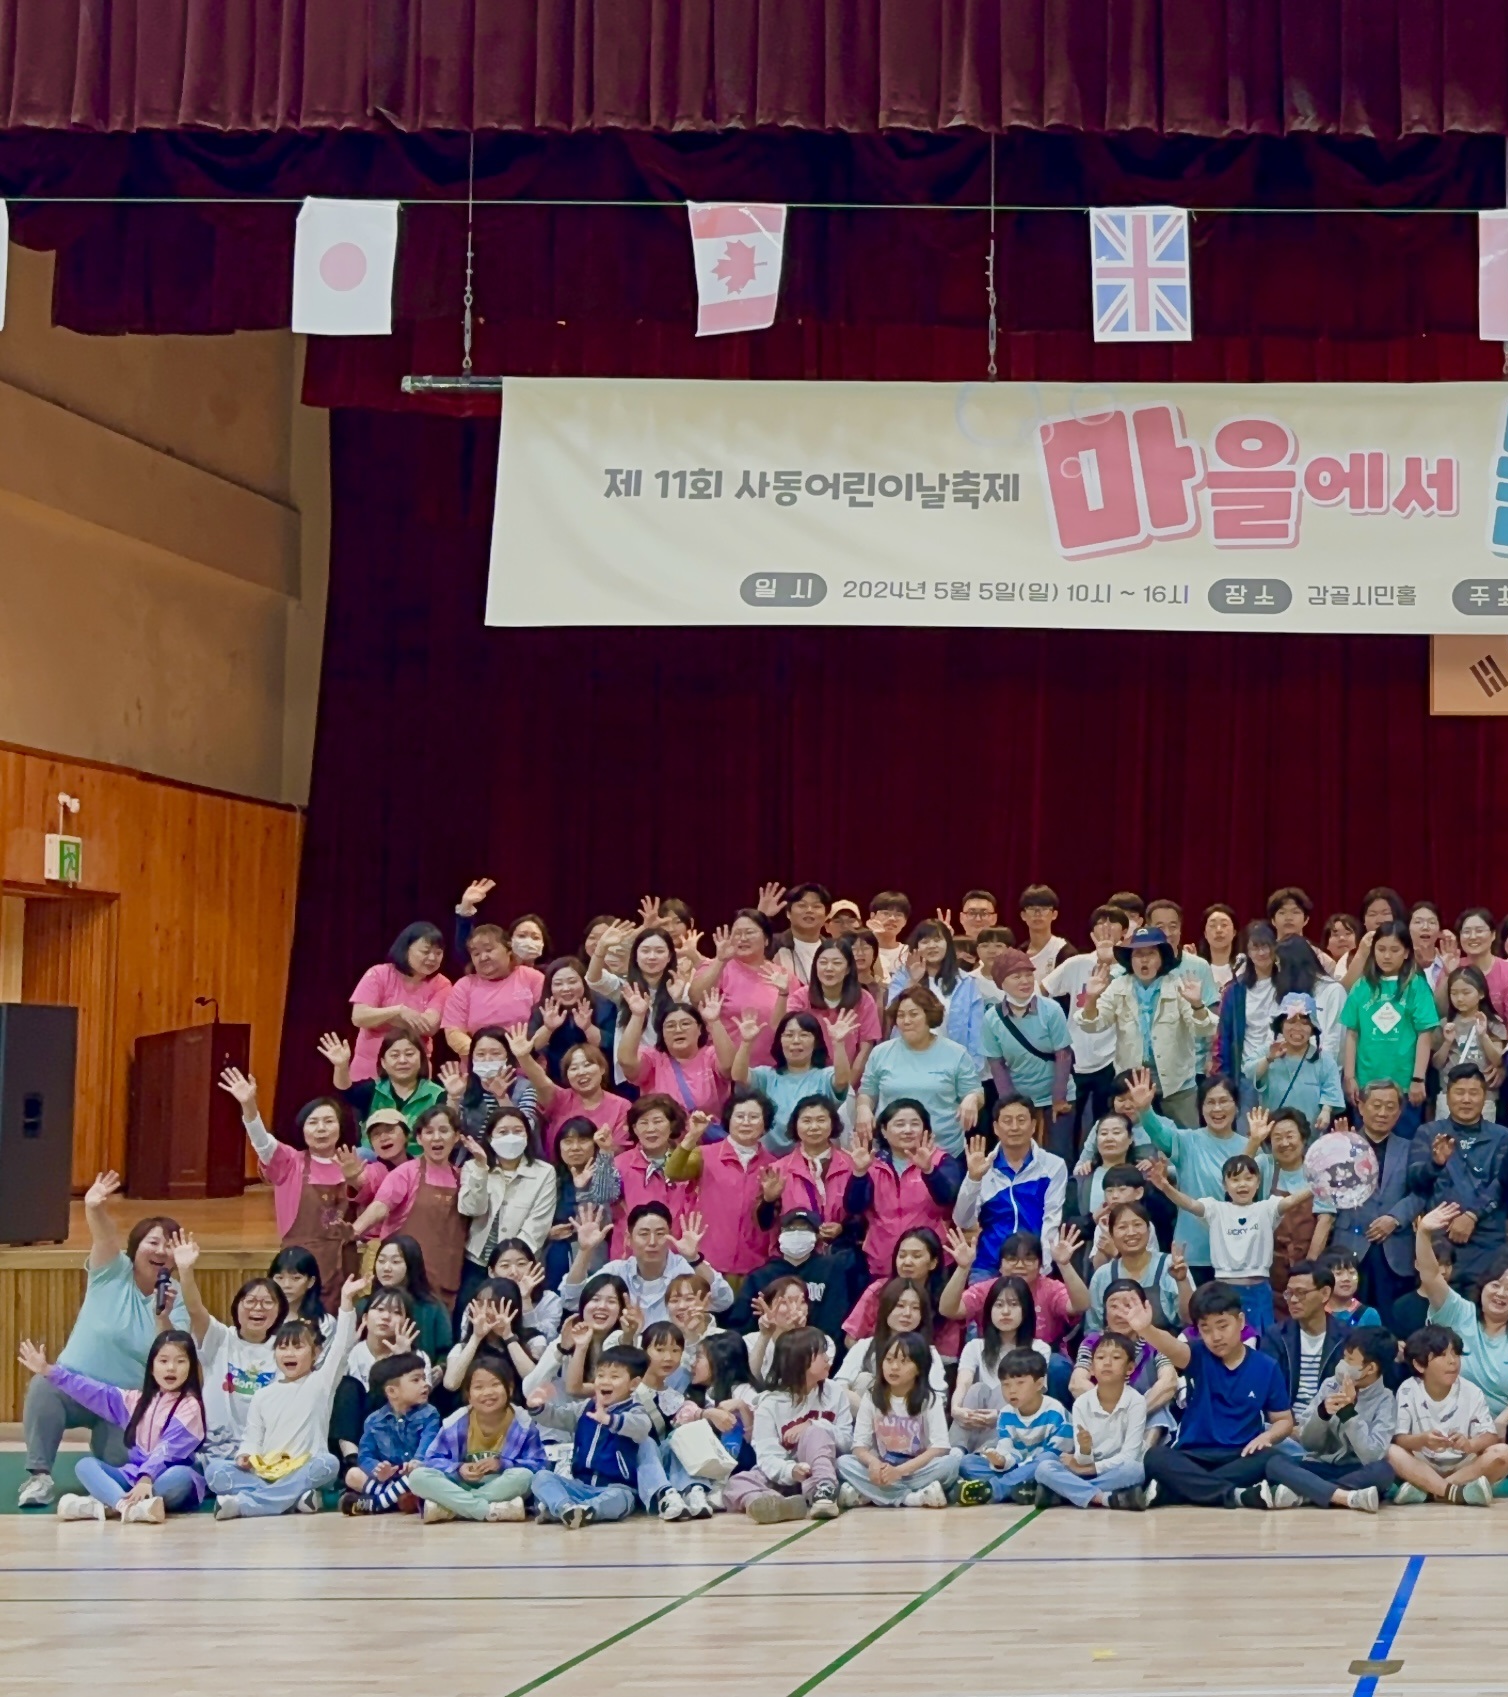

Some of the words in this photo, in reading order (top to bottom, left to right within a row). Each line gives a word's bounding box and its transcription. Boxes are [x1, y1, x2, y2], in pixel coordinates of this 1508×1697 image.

[604, 468, 642, 500] 제
[654, 467, 723, 501] 11회
[734, 468, 1020, 509] 사동어린이날축제
[1037, 402, 1459, 557] 마을에서
[843, 581, 926, 601] 2024년
[934, 582, 971, 601] 5월
[979, 582, 1058, 602] 5일(일)
[1067, 583, 1111, 604] 10시
[1144, 584, 1189, 605] 16시
[1307, 585, 1416, 607] 감골시민홀
